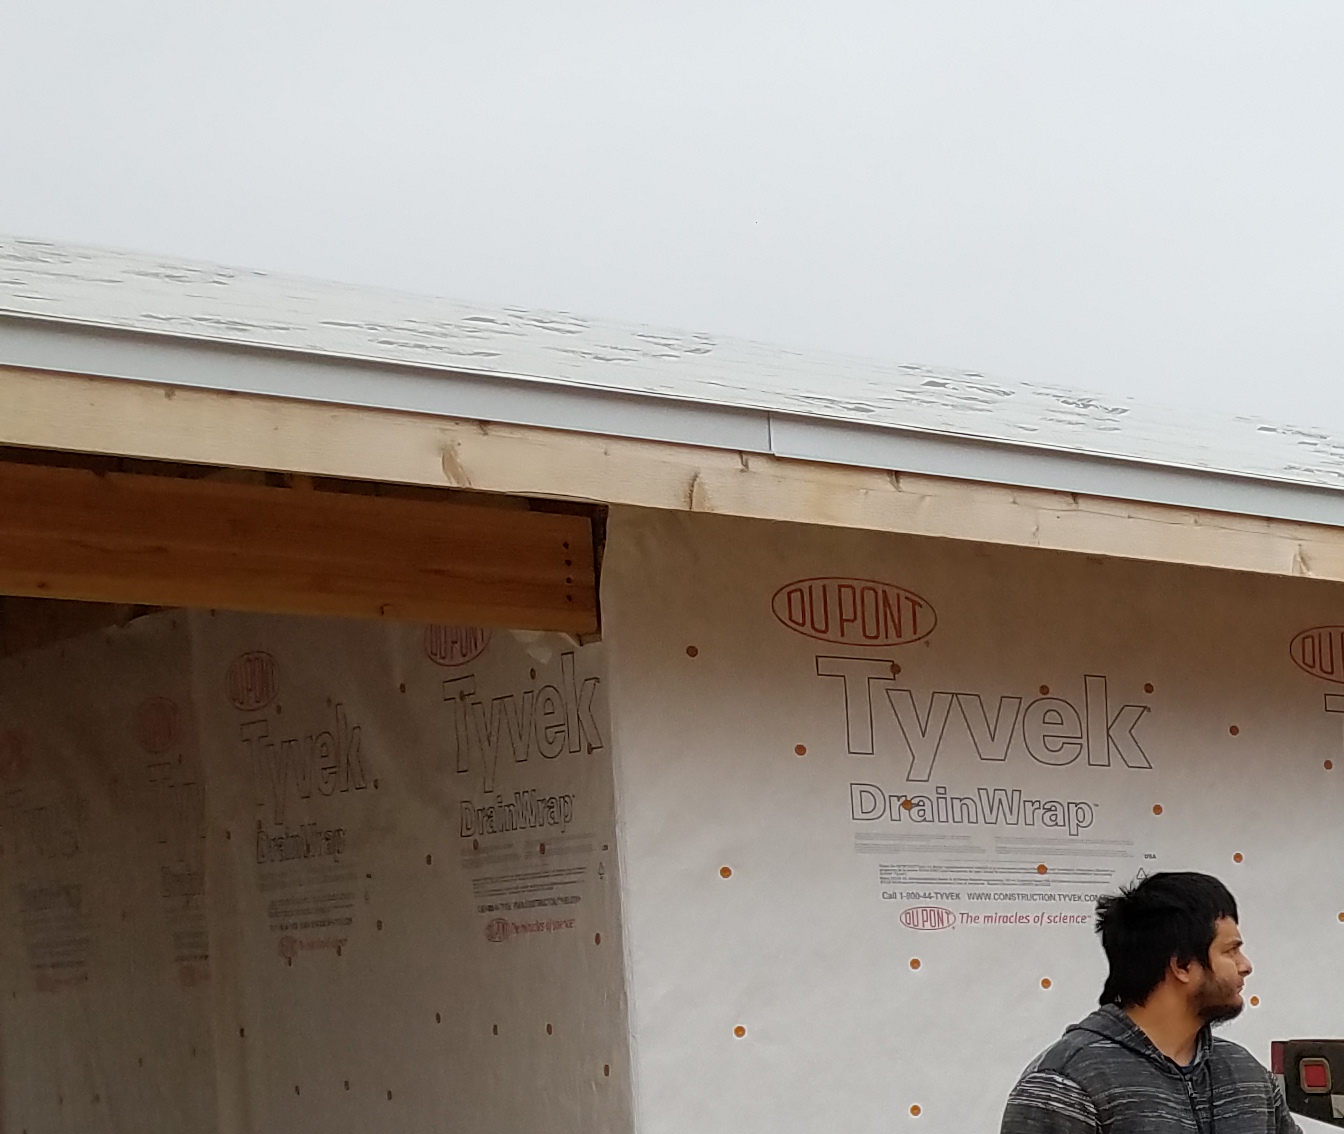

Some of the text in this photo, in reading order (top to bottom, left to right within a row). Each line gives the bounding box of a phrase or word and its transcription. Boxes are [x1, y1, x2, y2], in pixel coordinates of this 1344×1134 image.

[443, 651, 604, 794] Tyvek
[815, 655, 1153, 782] Tyvek
[460, 788, 574, 839] DrainWrap
[849, 782, 1094, 836] DrainWrap
[881, 891, 897, 900] Call
[959, 912, 980, 925] The
[983, 912, 1030, 925] miracles
[1033, 912, 1046, 927] of
[1047, 913, 1087, 925] science
